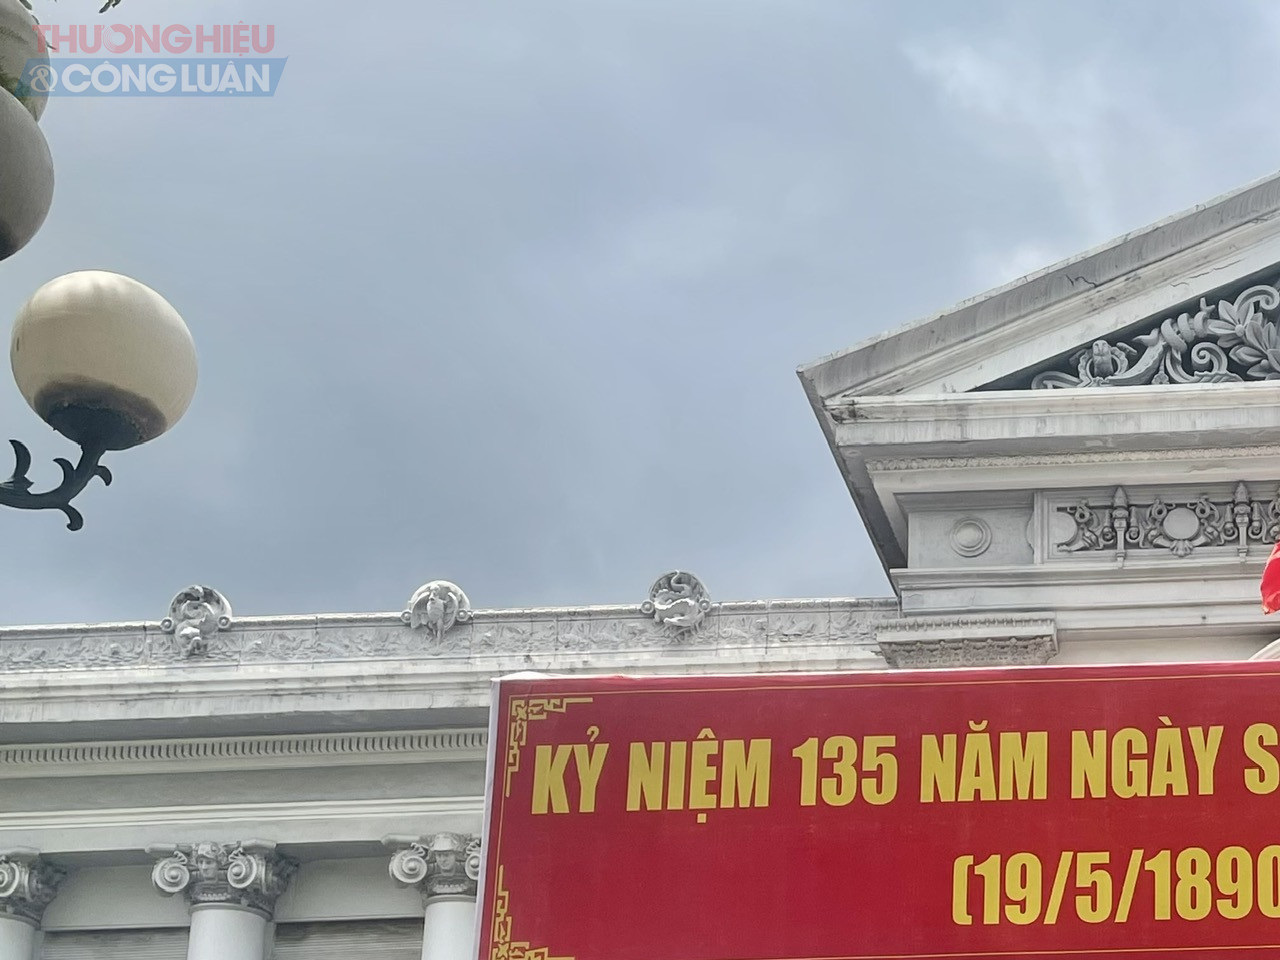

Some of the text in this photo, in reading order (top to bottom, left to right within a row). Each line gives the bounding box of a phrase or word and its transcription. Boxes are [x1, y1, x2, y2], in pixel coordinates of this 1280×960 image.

[531, 725, 609, 814] KỶ
[626, 727, 771, 823] NIỆM
[792, 735, 898, 806] 135
[920, 719, 1048, 802] NĂM
[1071, 715, 1224, 799] NGÀY
